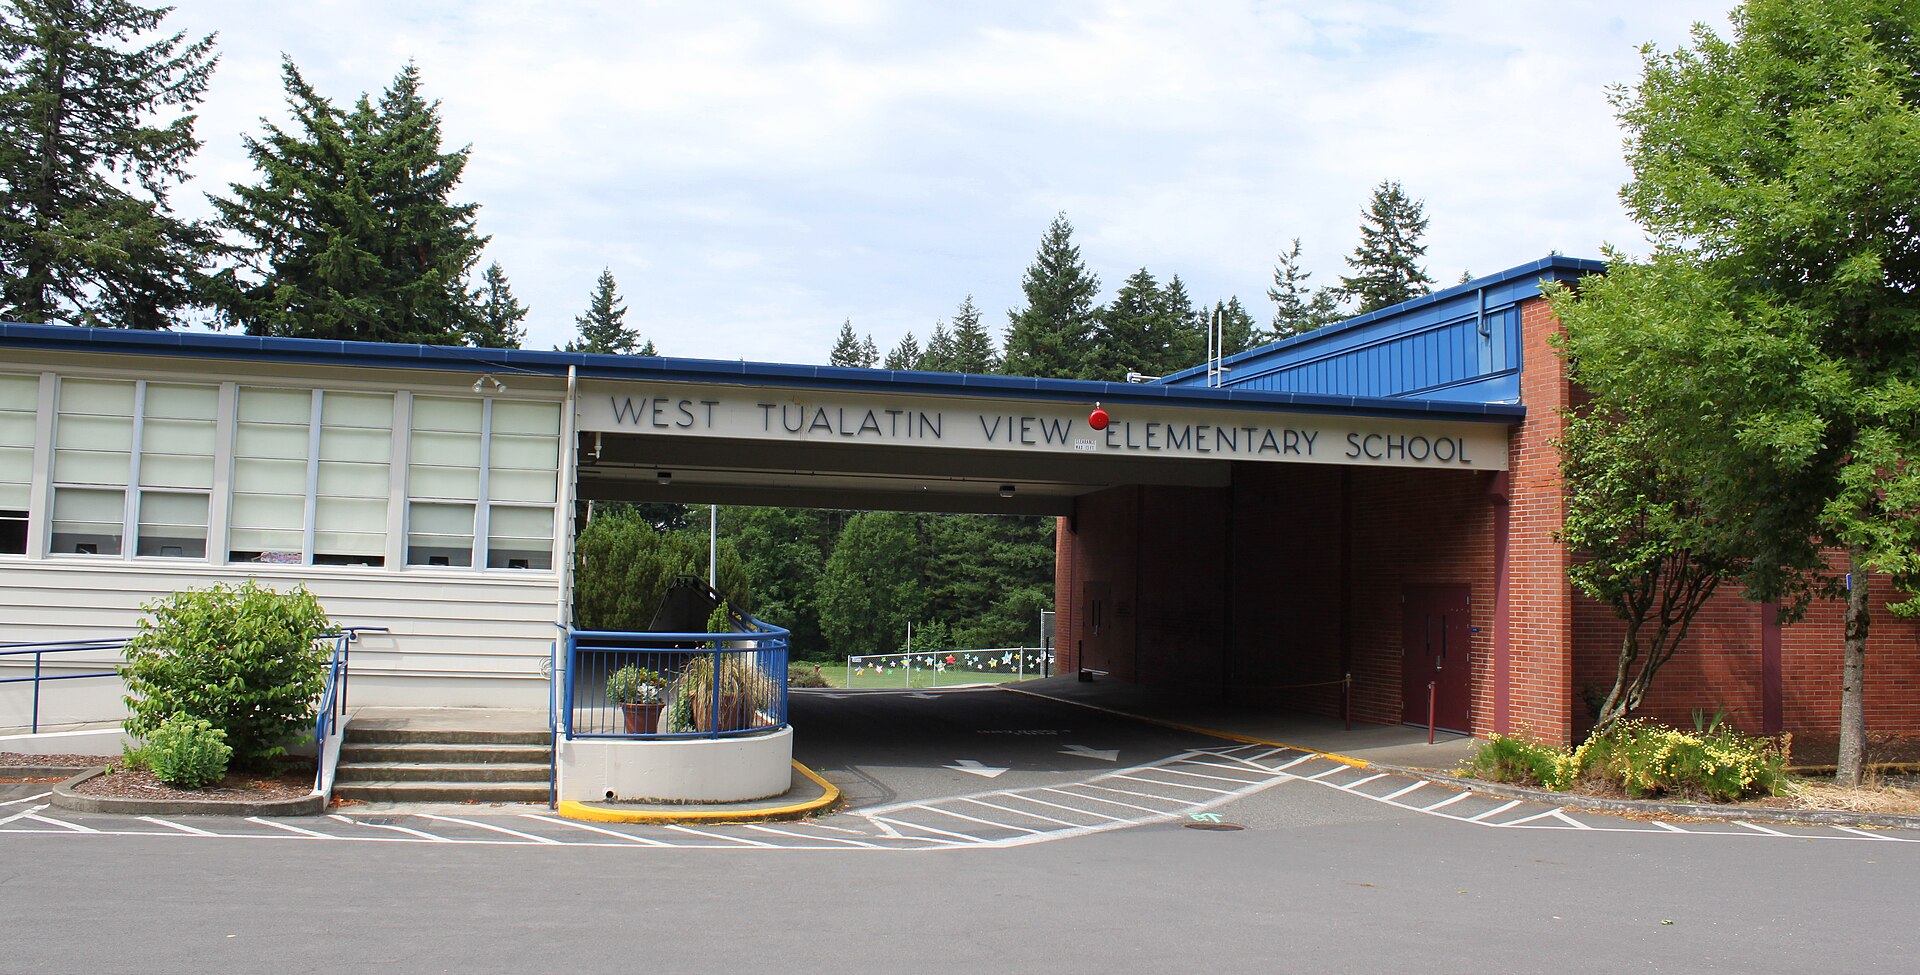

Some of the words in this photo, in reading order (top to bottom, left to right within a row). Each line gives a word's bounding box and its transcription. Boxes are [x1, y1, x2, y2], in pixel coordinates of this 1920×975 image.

[611, 396, 720, 428] WEST
[757, 403, 942, 439] TUALATIN
[979, 415, 1073, 445] VIEW
[1105, 420, 1319, 455] ELEMENTARY
[1345, 432, 1472, 463] SCHOOL
